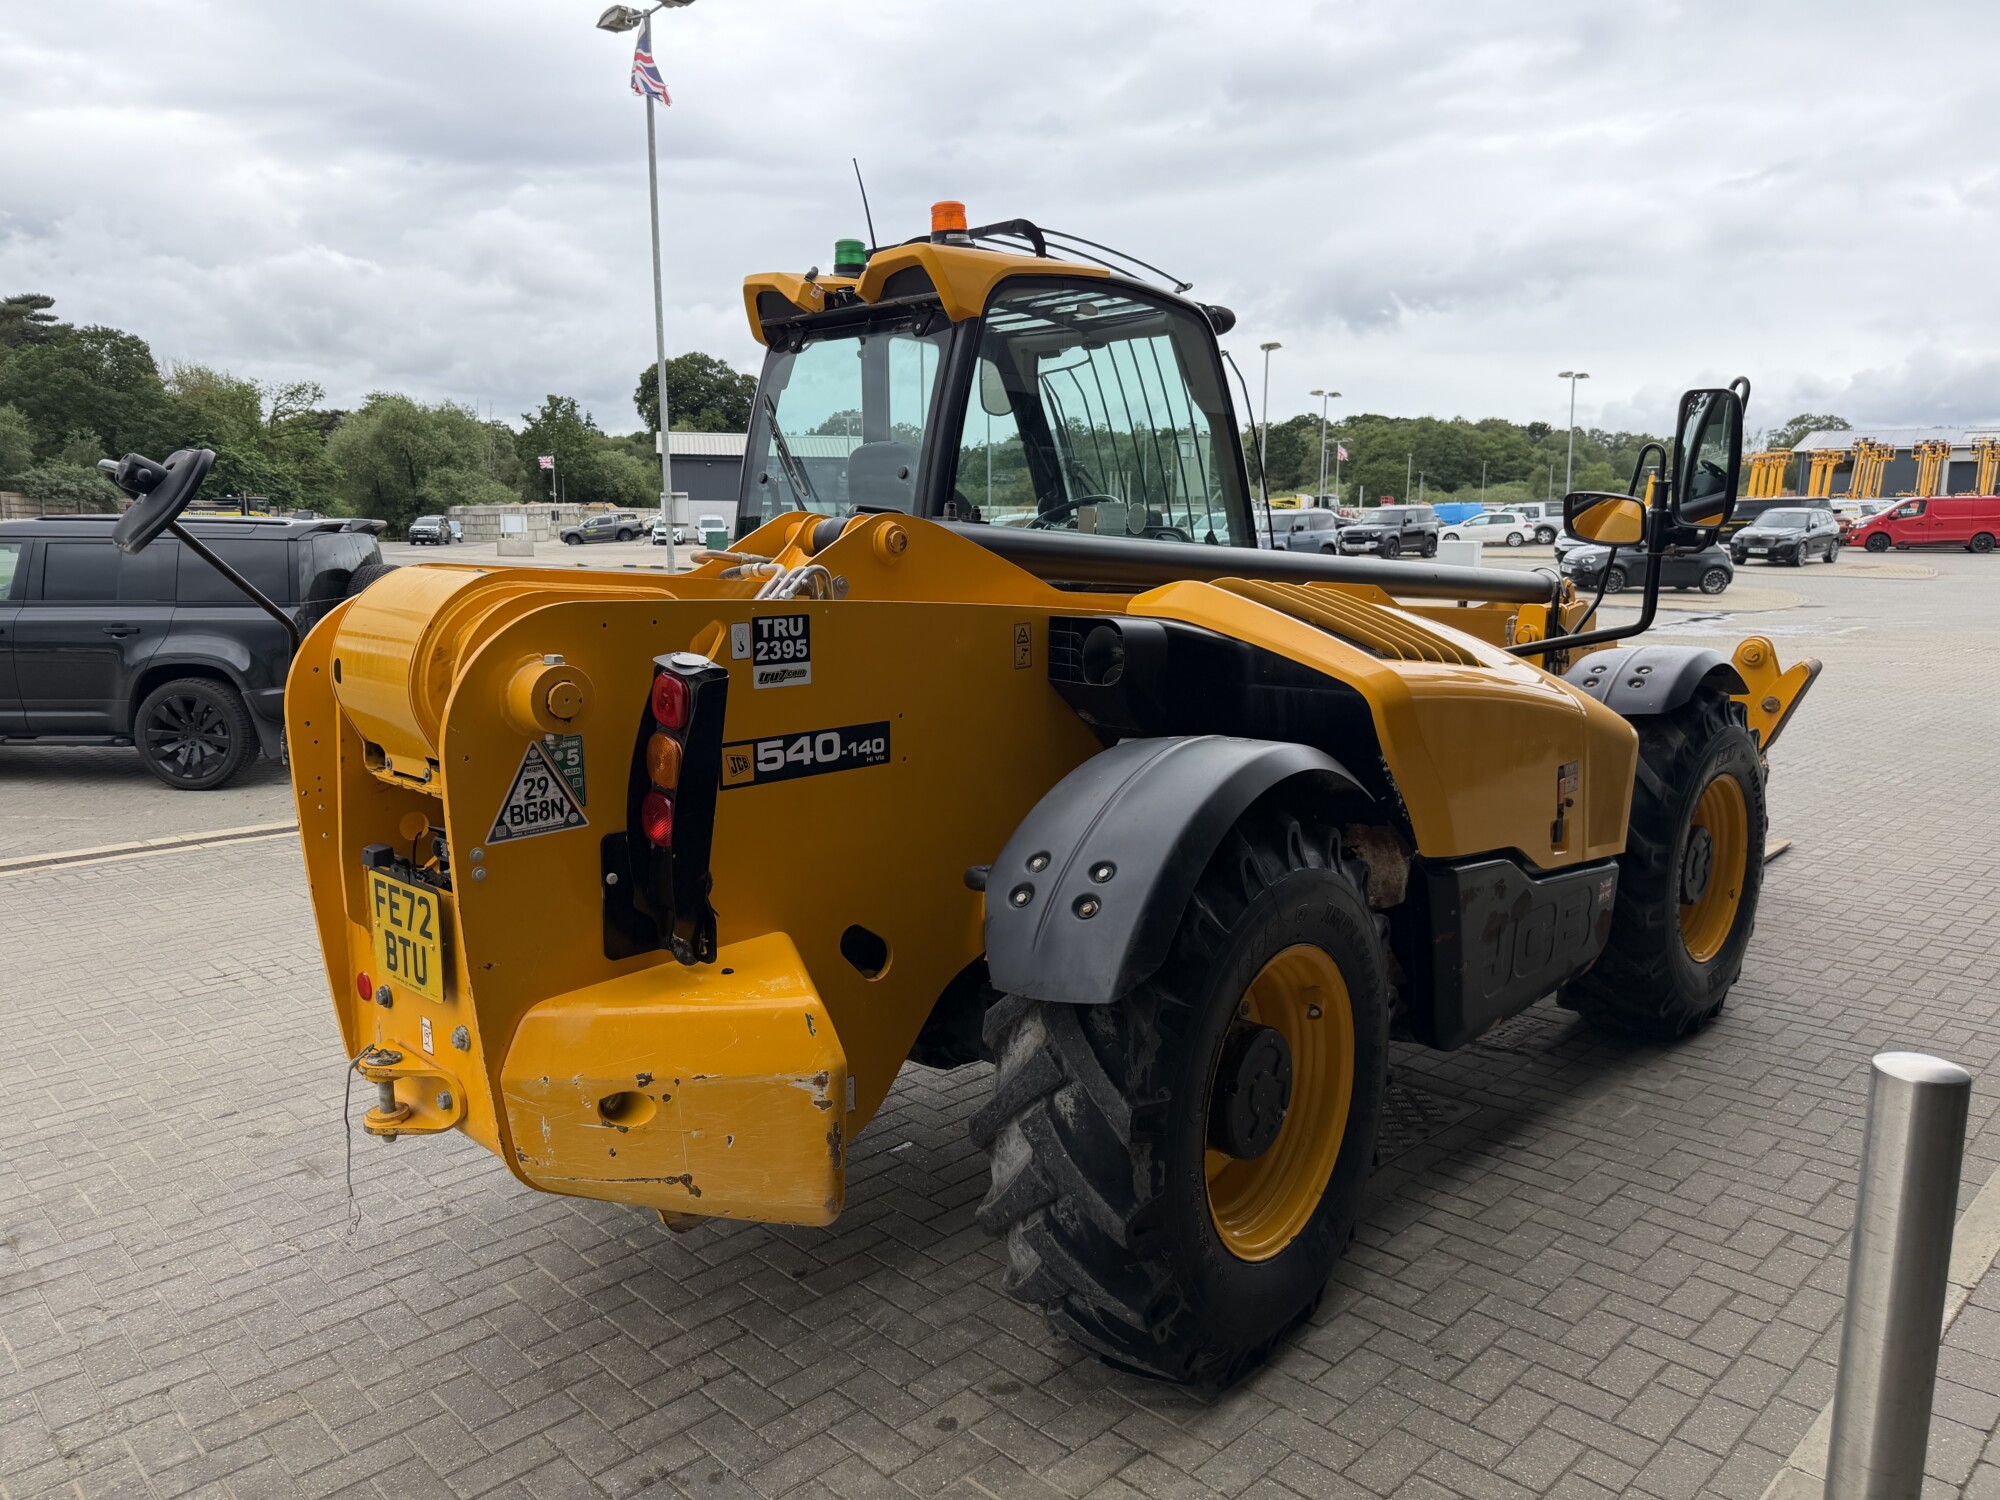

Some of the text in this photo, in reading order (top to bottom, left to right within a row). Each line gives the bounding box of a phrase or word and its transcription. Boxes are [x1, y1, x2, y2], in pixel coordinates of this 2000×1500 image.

[758, 617, 803, 638] TRU
[756, 639, 808, 661] 2395
[758, 669, 807, 684] tru7.com
[566, 748, 580, 766] 5
[729, 755, 750, 774] JCB
[523, 776, 549, 800] 29
[509, 797, 565, 827] BG8N
[374, 878, 433, 940] FE72
[1482, 886, 1594, 999] JCB
[384, 929, 427, 986] BTU
